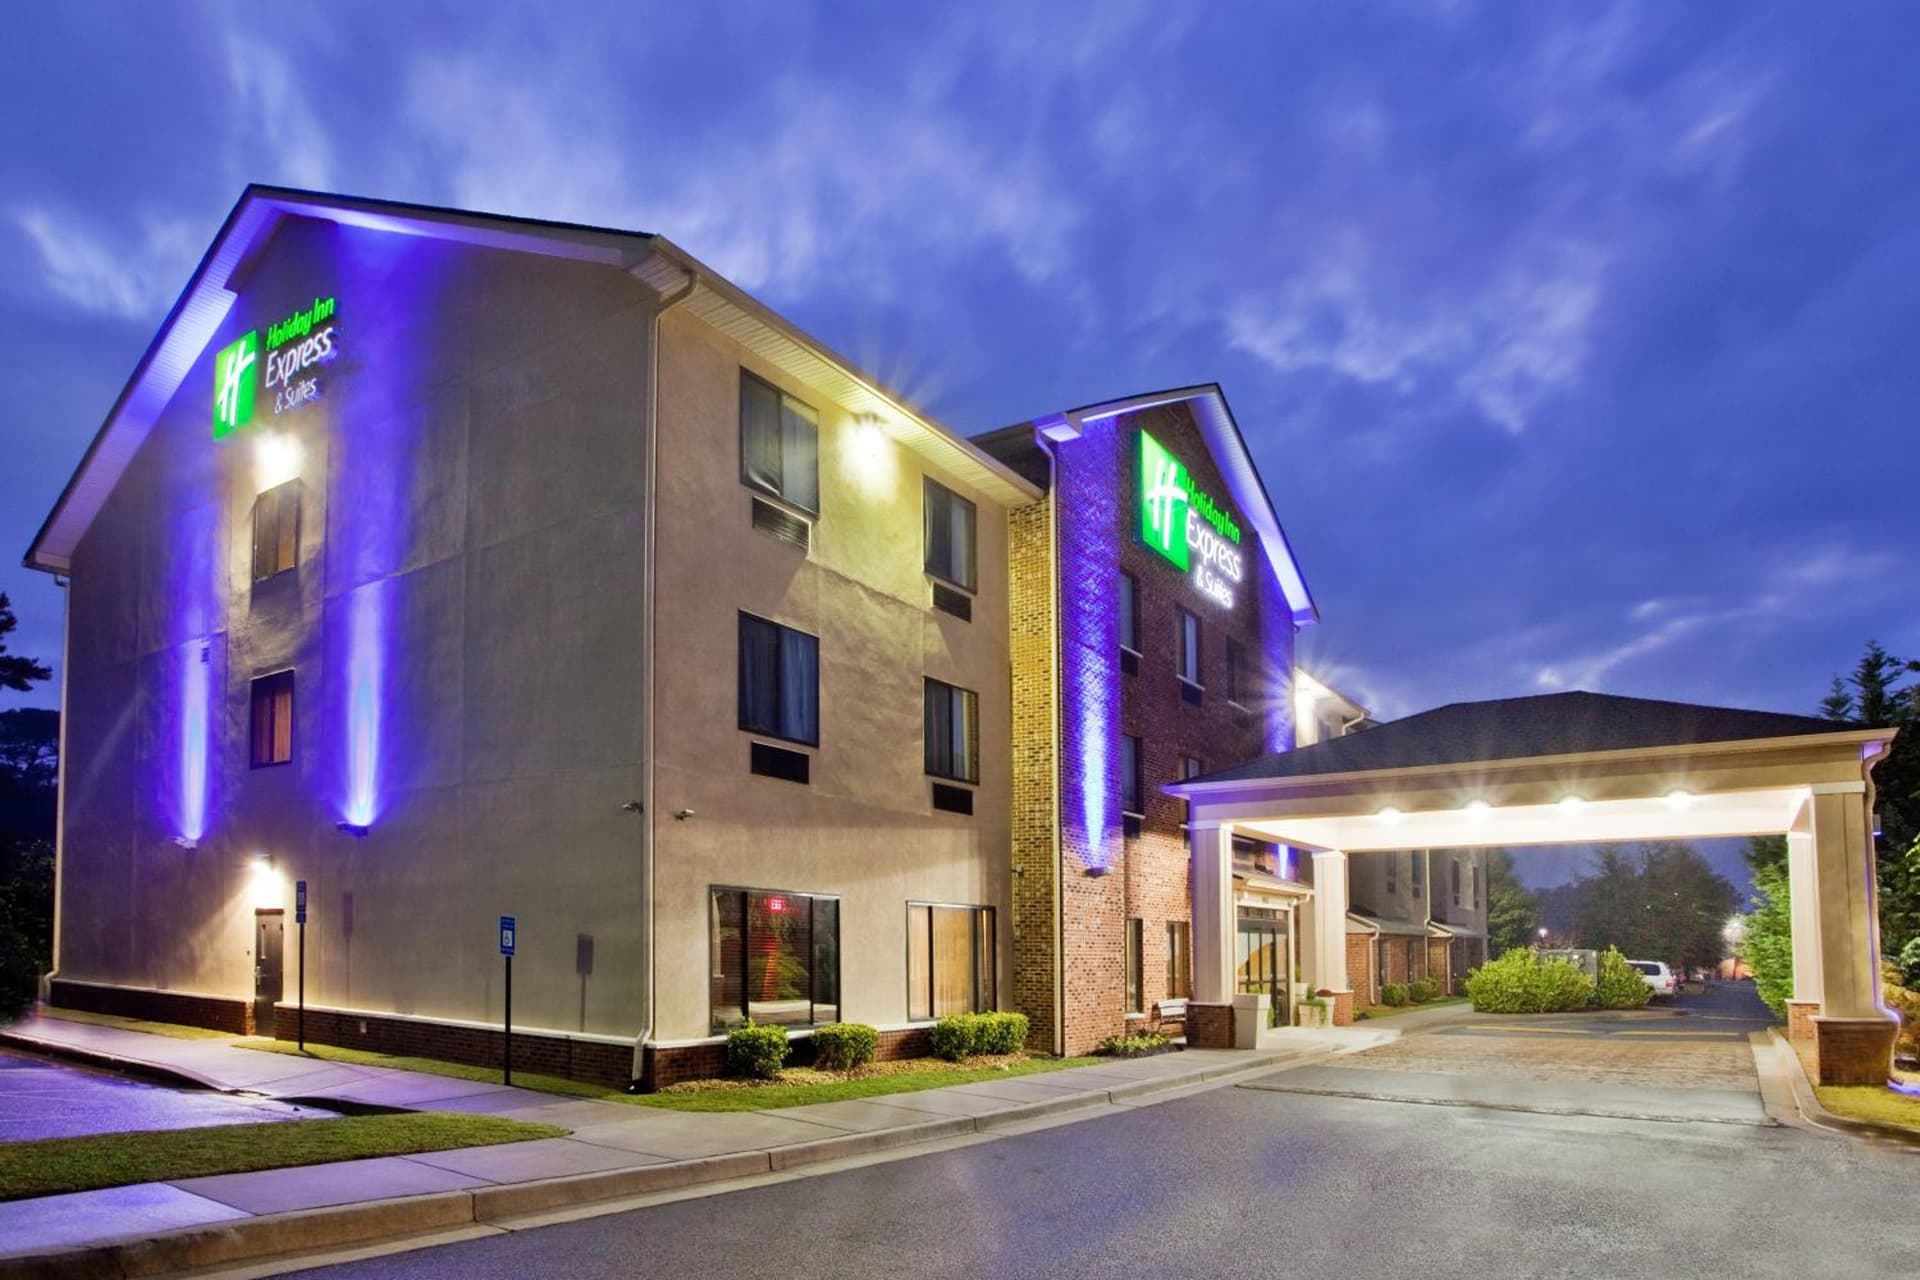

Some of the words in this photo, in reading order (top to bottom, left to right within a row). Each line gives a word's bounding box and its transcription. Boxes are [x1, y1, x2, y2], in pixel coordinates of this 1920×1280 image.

[266, 311, 312, 351] Holiday
[313, 297, 335, 324] Inn
[265, 327, 334, 388] Express
[274, 392, 283, 414] &
[284, 378, 318, 410] Suites
[1186, 476, 1225, 536] Holiday
[1224, 512, 1241, 545] Inn
[1185, 507, 1242, 584] Express
[1195, 565, 1204, 590] &
[1203, 571, 1234, 610] Suites
